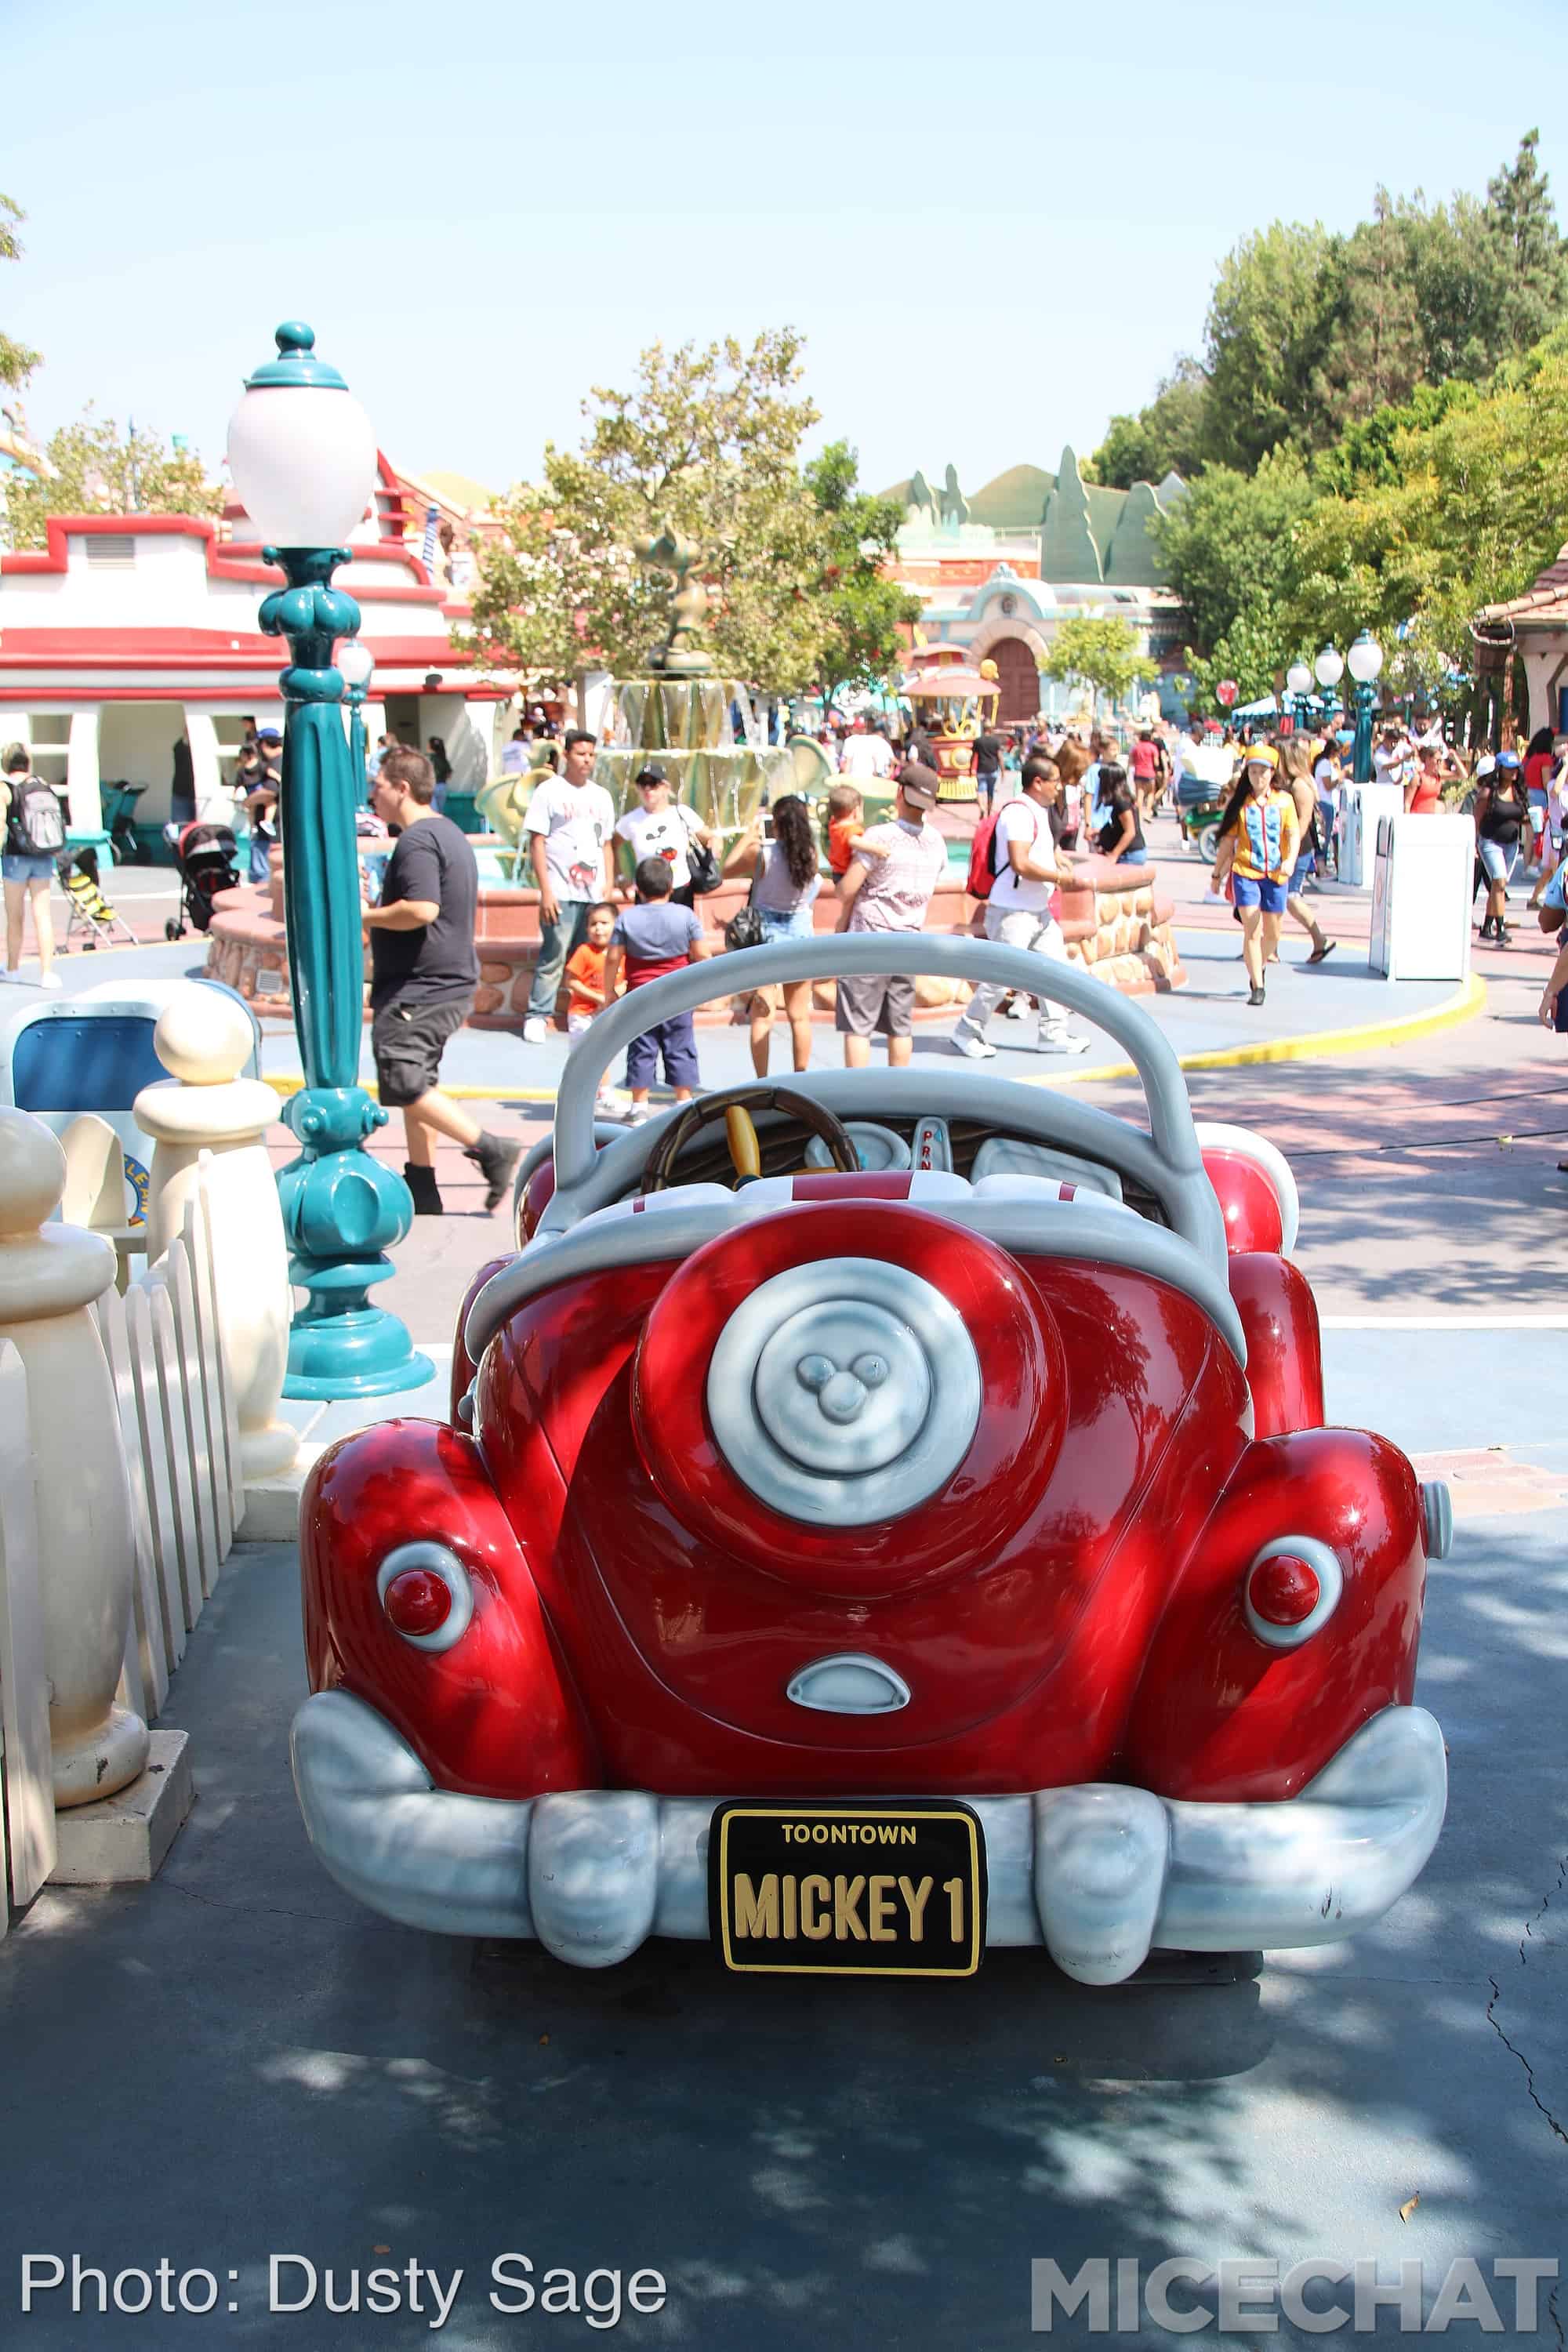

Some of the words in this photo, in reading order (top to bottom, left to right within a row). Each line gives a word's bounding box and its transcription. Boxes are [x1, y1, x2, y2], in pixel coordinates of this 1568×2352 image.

[924, 1131, 932, 1142] P
[922, 1145, 931, 1157] R
[782, 1824, 916, 1845] TOONTOWN
[734, 1873, 934, 1942] MICKEY
[942, 1877, 964, 1943] 1
